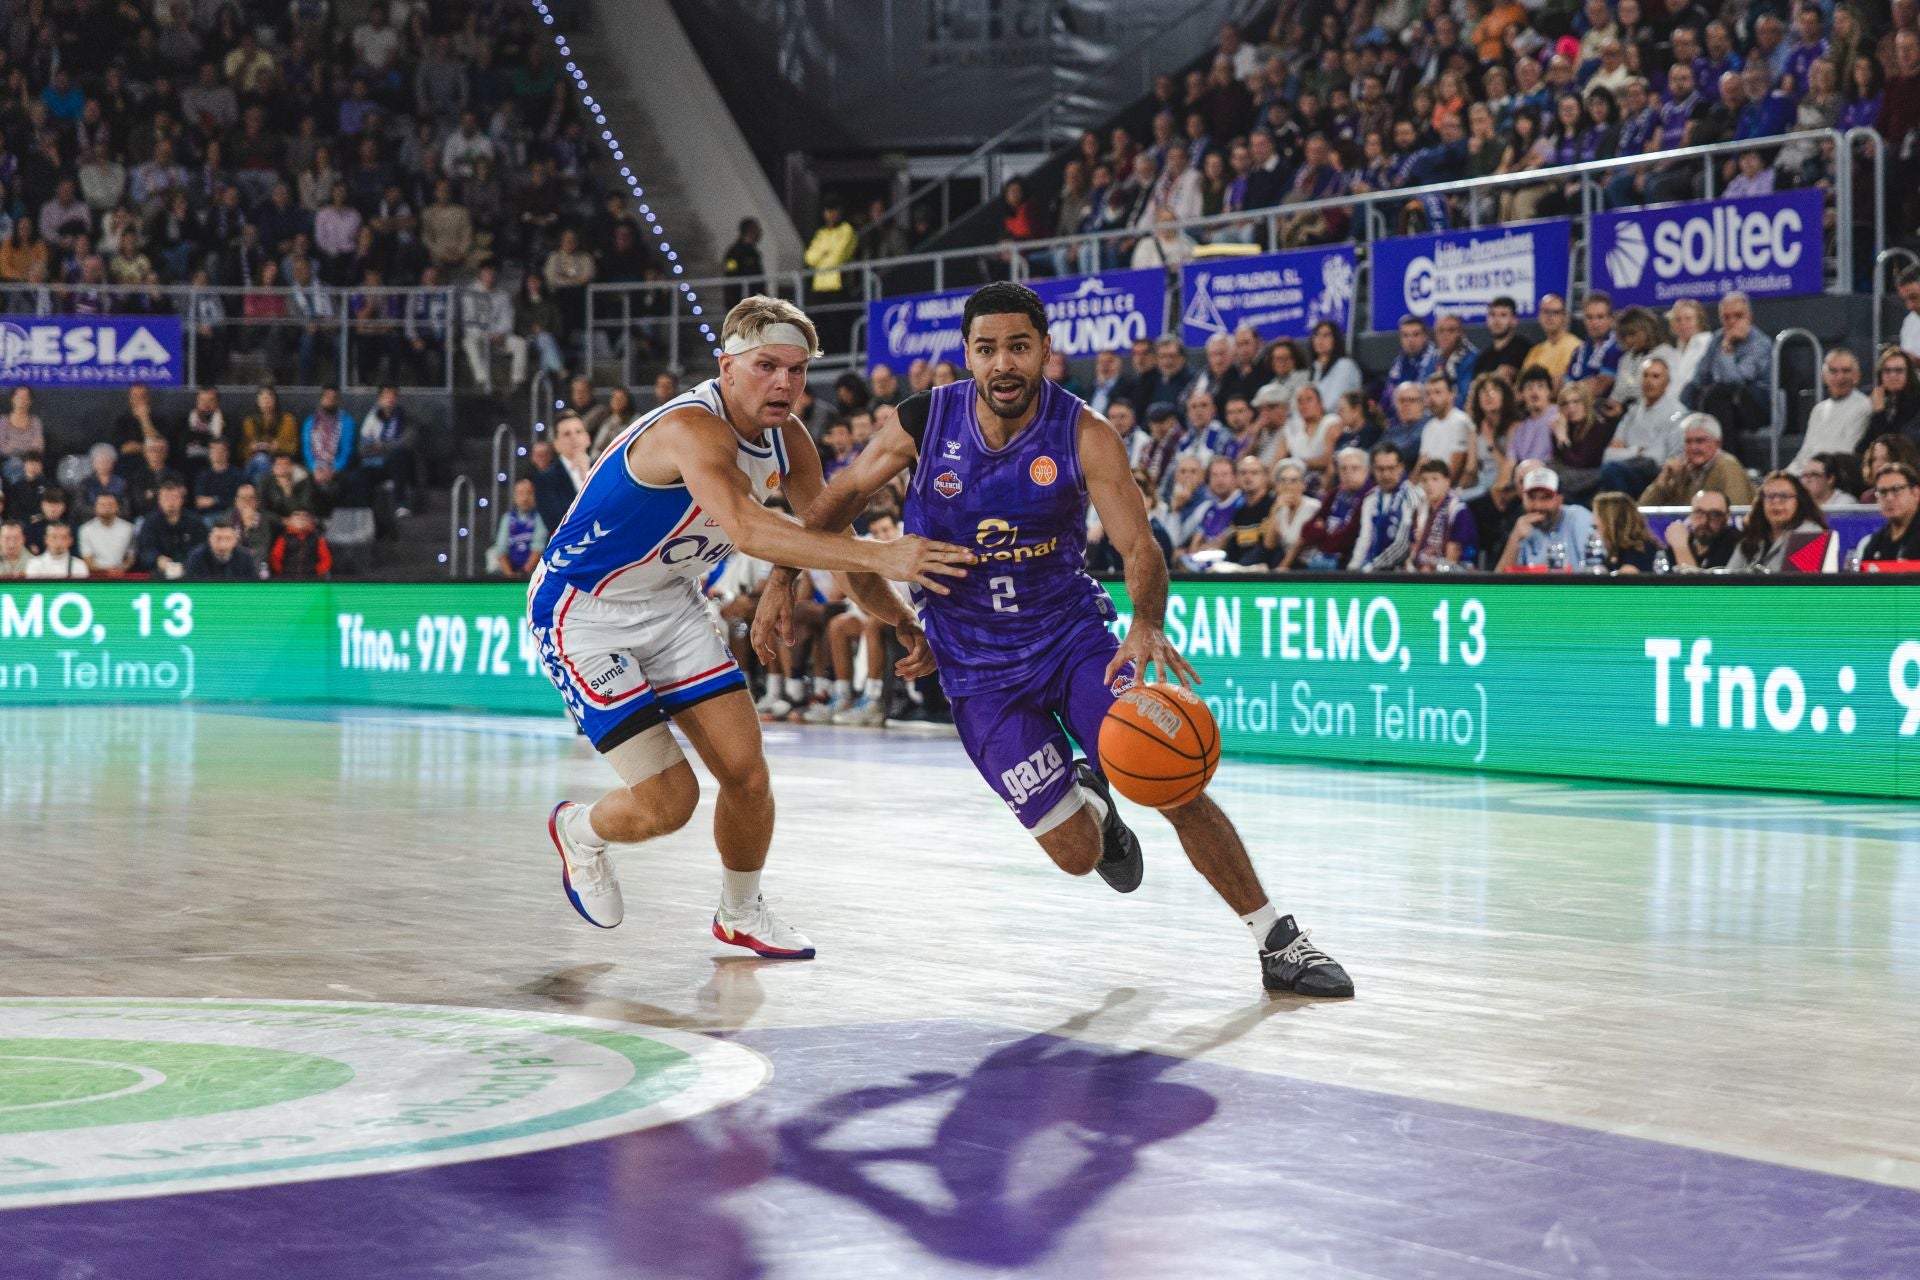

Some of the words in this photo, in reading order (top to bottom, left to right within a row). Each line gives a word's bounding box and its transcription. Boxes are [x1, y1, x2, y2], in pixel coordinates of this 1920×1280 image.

[1653, 206, 1802, 278] soltec
[0, 592, 106, 645] MO,
[131, 592, 194, 637] 13
[989, 576, 1019, 613] 2
[338, 613, 410, 672] Tfno.:
[416, 615, 468, 673] 979
[475, 616, 511, 675] 72
[1166, 594, 1241, 658] SAN
[1255, 595, 1411, 673] TELMO,
[1432, 599, 1488, 666] 13
[57, 645, 195, 699] Telmo)
[590, 664, 625, 690] suma
[1644, 637, 1857, 736] Tfno.:
[1888, 639, 1920, 736] 9
[1291, 681, 1356, 738] San
[1368, 684, 1488, 763] Telmo)
[1000, 742, 1064, 804] gaza
